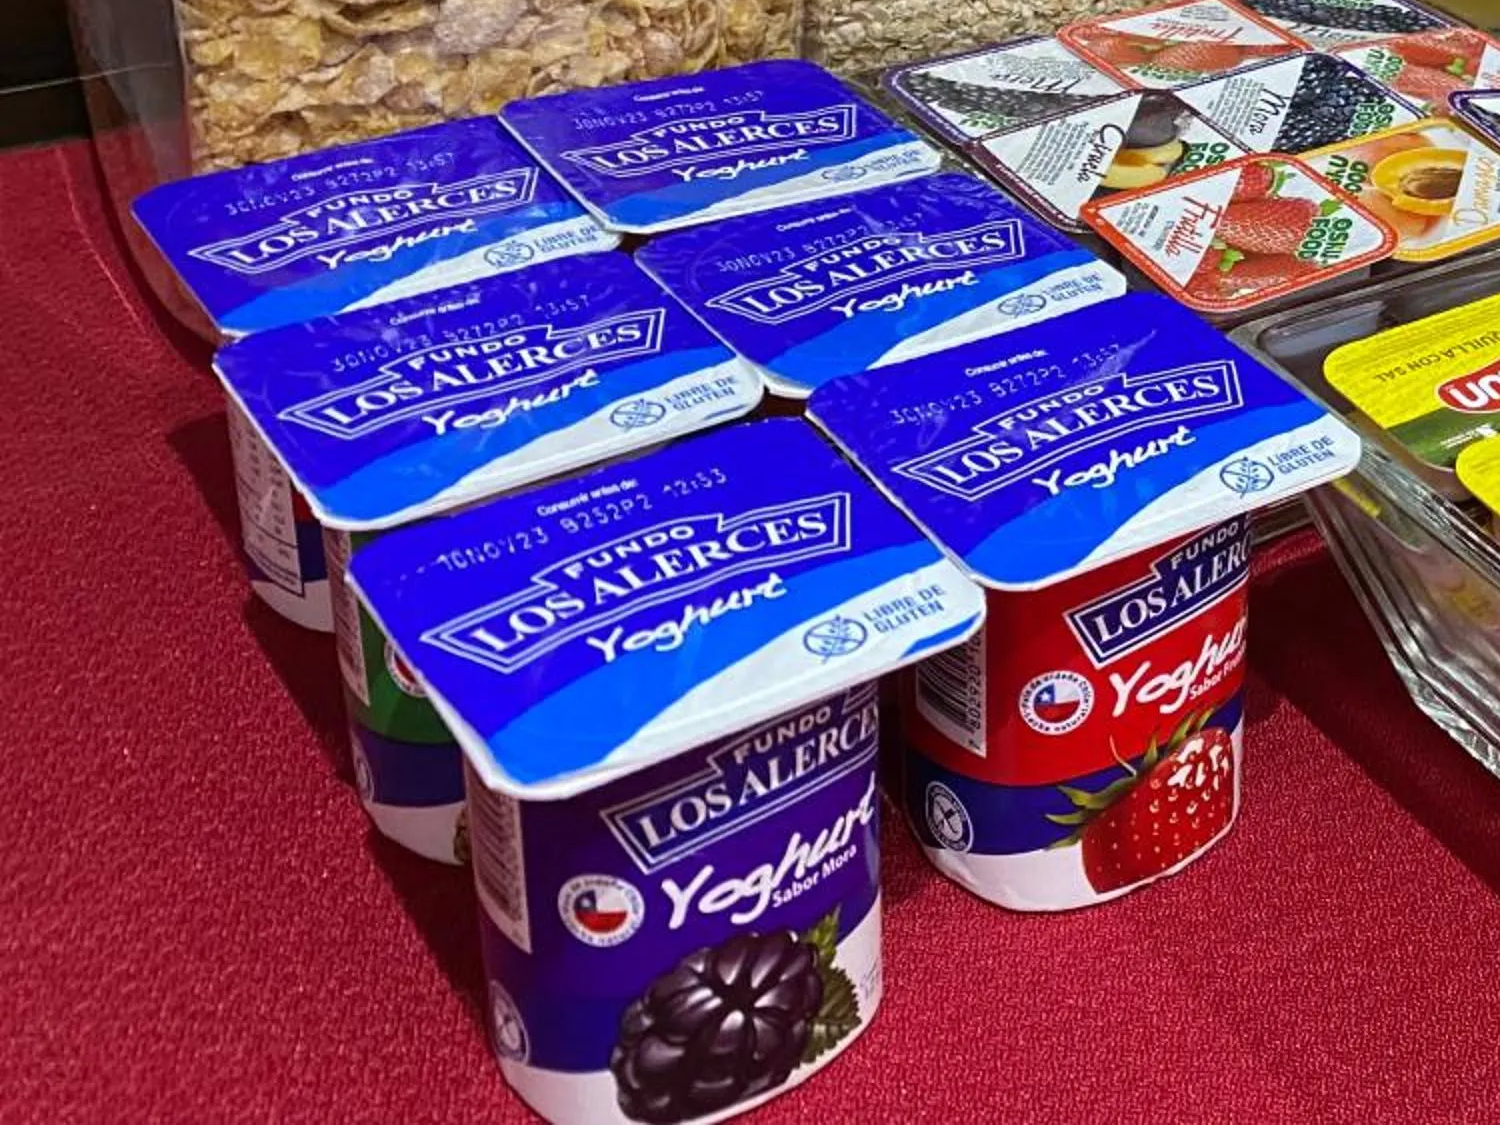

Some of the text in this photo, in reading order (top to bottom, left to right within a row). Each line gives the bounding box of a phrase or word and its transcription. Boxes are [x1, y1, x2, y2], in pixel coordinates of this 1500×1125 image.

[591, 116, 840, 170] LOS ALERCES
[652, 116, 745, 138] FUNDO
[672, 148, 811, 183] Yoghurt
[229, 179, 518, 264] LOS ALERCES
[306, 190, 414, 219] FUNDO
[317, 219, 479, 269] Yoghurt
[804, 237, 900, 272] FUNDO
[743, 230, 1006, 315] LOS ALERCES
[831, 271, 980, 319] Yoghurt
[322, 322, 642, 426] LOS ALERCES
[407, 334, 527, 371] FUNDO
[422, 369, 602, 437] Yoghurt
[998, 385, 1105, 431] FUNDO
[934, 375, 1224, 485] LOS ALERCES
[1267, 435, 1335, 468] LIBRE DE
[1032, 425, 1198, 497] Yoghurt
[1276, 449, 1336, 475] GLUTEN
[563, 526, 695, 579] FUNDO
[1170, 523, 1240, 571] FUNDO
[470, 510, 829, 653] LOS ALERCES
[862, 584, 946, 623] LIBRE DE
[586, 573, 788, 663] Yoghurt
[873, 600, 945, 634] GLUTEN
[1093, 587, 1168, 645] LOS
[1188, 673, 1224, 701] Sabor
[732, 706, 832, 764] FUNDO
[637, 700, 879, 848] LOS ALERCE
[660, 770, 877, 930] Yoghurt
[771, 844, 858, 909] Sabor Mora
